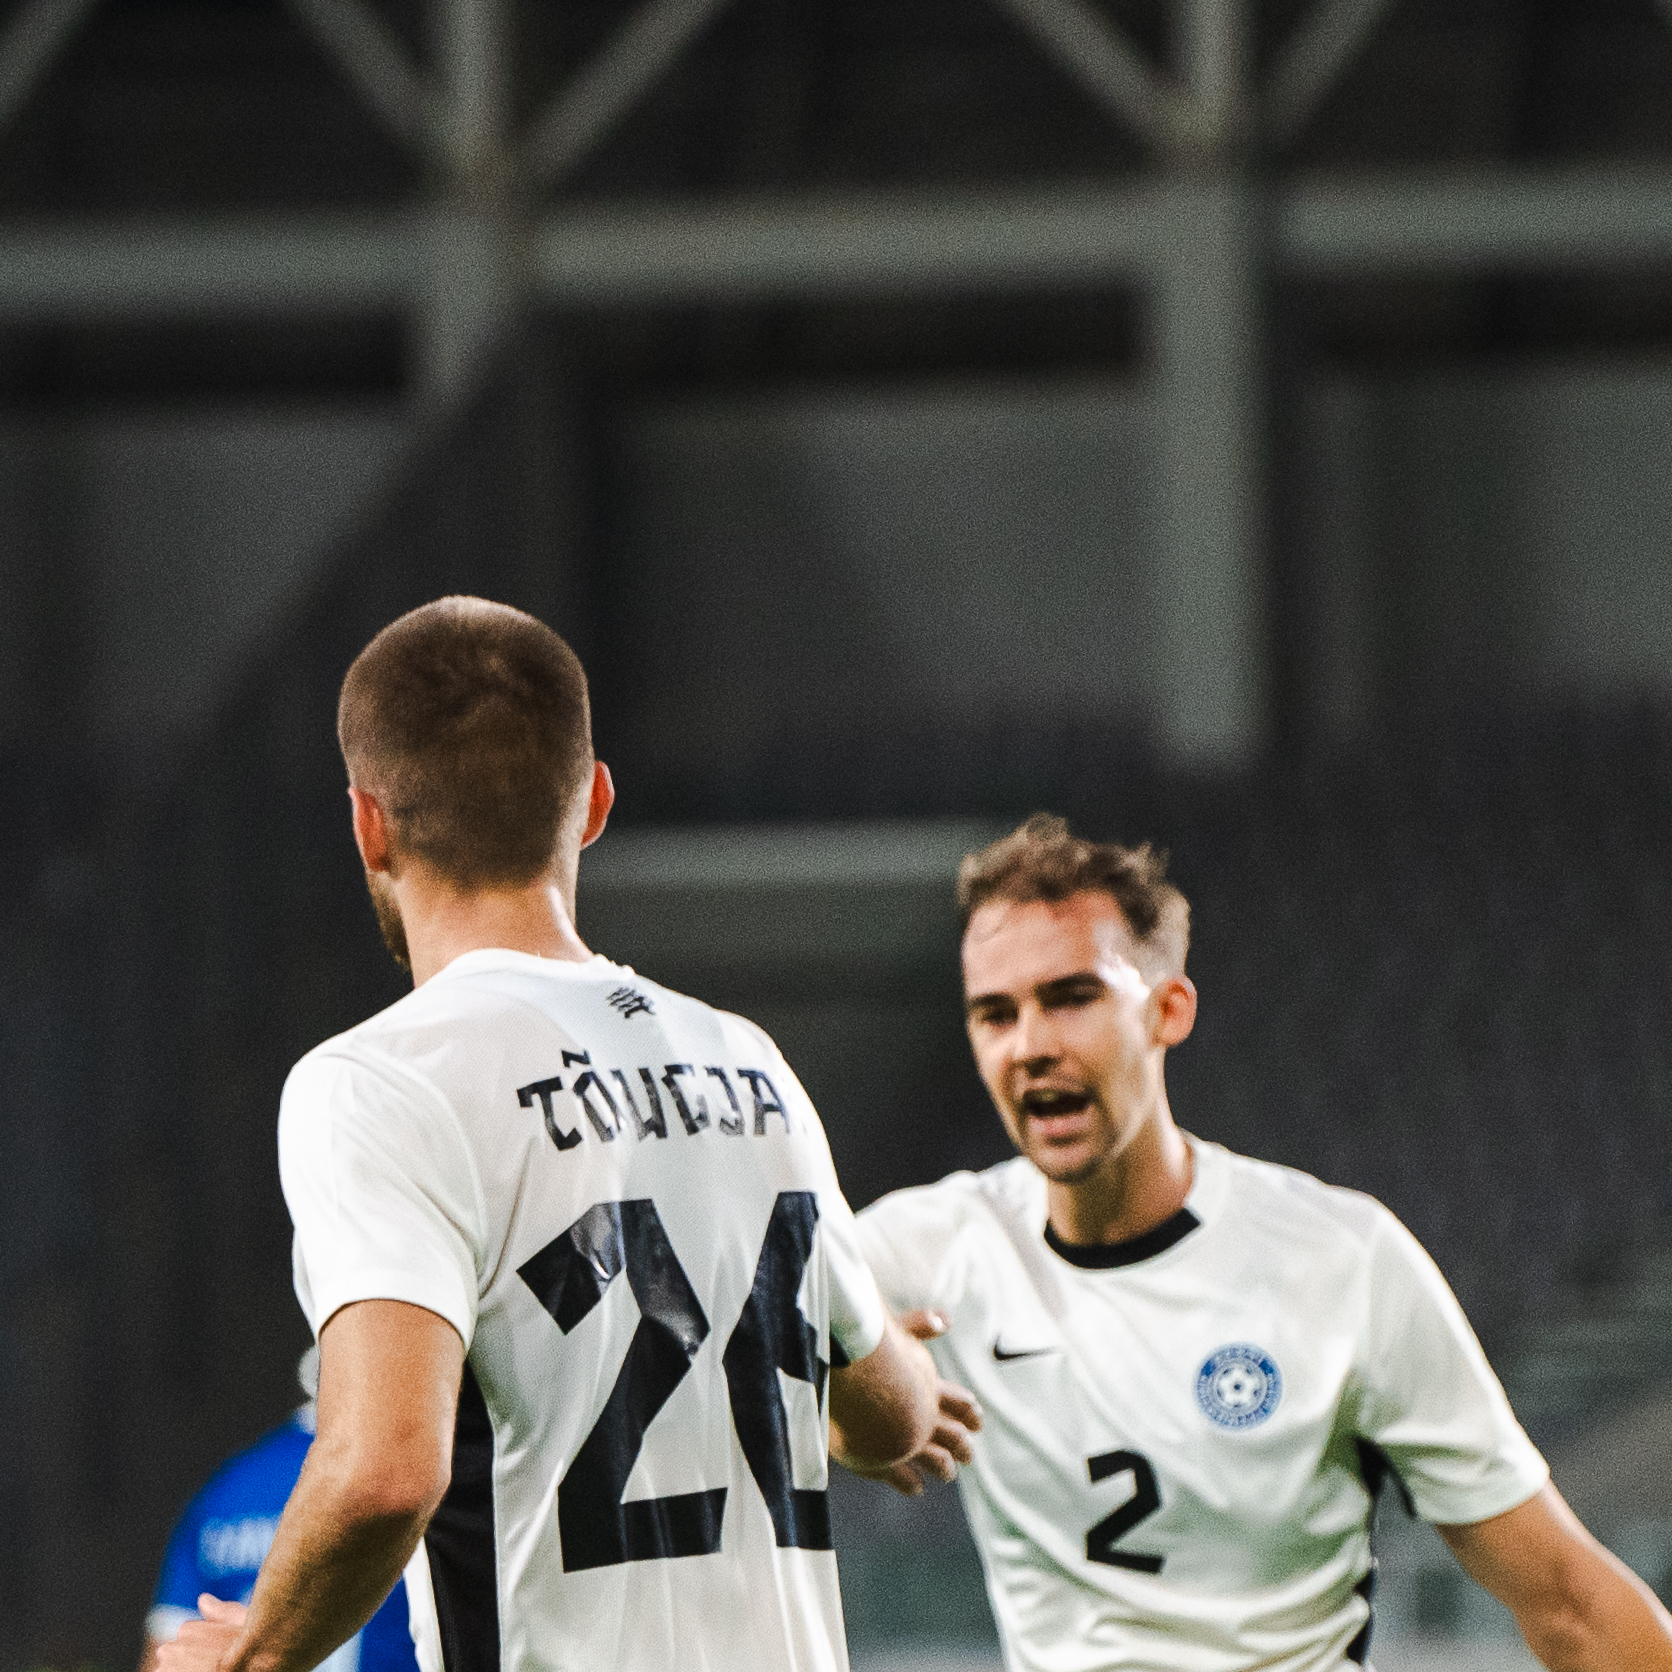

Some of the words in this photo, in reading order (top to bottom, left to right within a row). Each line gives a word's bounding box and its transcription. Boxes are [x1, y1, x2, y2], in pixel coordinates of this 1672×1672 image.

[516, 1048, 804, 1152] TÕUGJA
[516, 1190, 835, 1573] 26
[1086, 1450, 1166, 1574] 2
